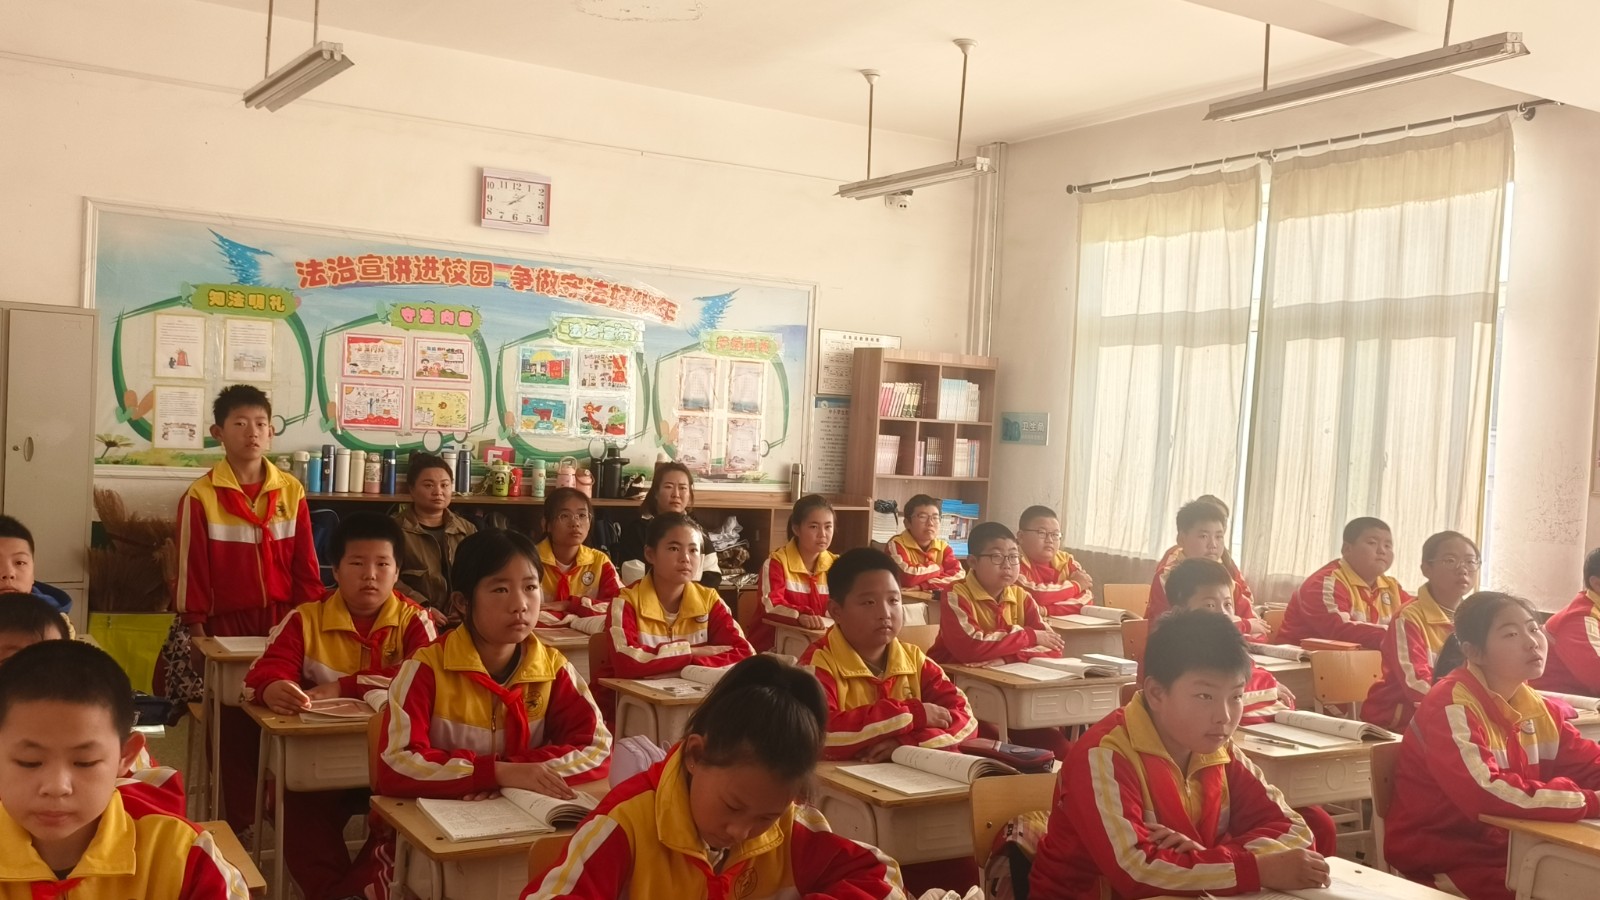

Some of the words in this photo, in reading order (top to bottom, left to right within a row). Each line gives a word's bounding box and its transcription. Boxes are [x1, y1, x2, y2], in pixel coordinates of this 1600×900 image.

[487, 181, 494, 189] 10
[501, 181, 508, 189] 11
[513, 182, 522, 191] 12
[538, 188, 545, 197] 2
[487, 194, 493, 202] 9
[537, 201, 544, 210] 3
[486, 207, 493, 215] 8
[499, 211, 504, 219] 7
[512, 213, 518, 222] 6
[526, 214, 532, 223] 5
[295, 254, 494, 289] 法治宣讲进校园
[207, 289, 286, 312] 知法明礼
[1021, 420, 1045, 432] 卫生角
